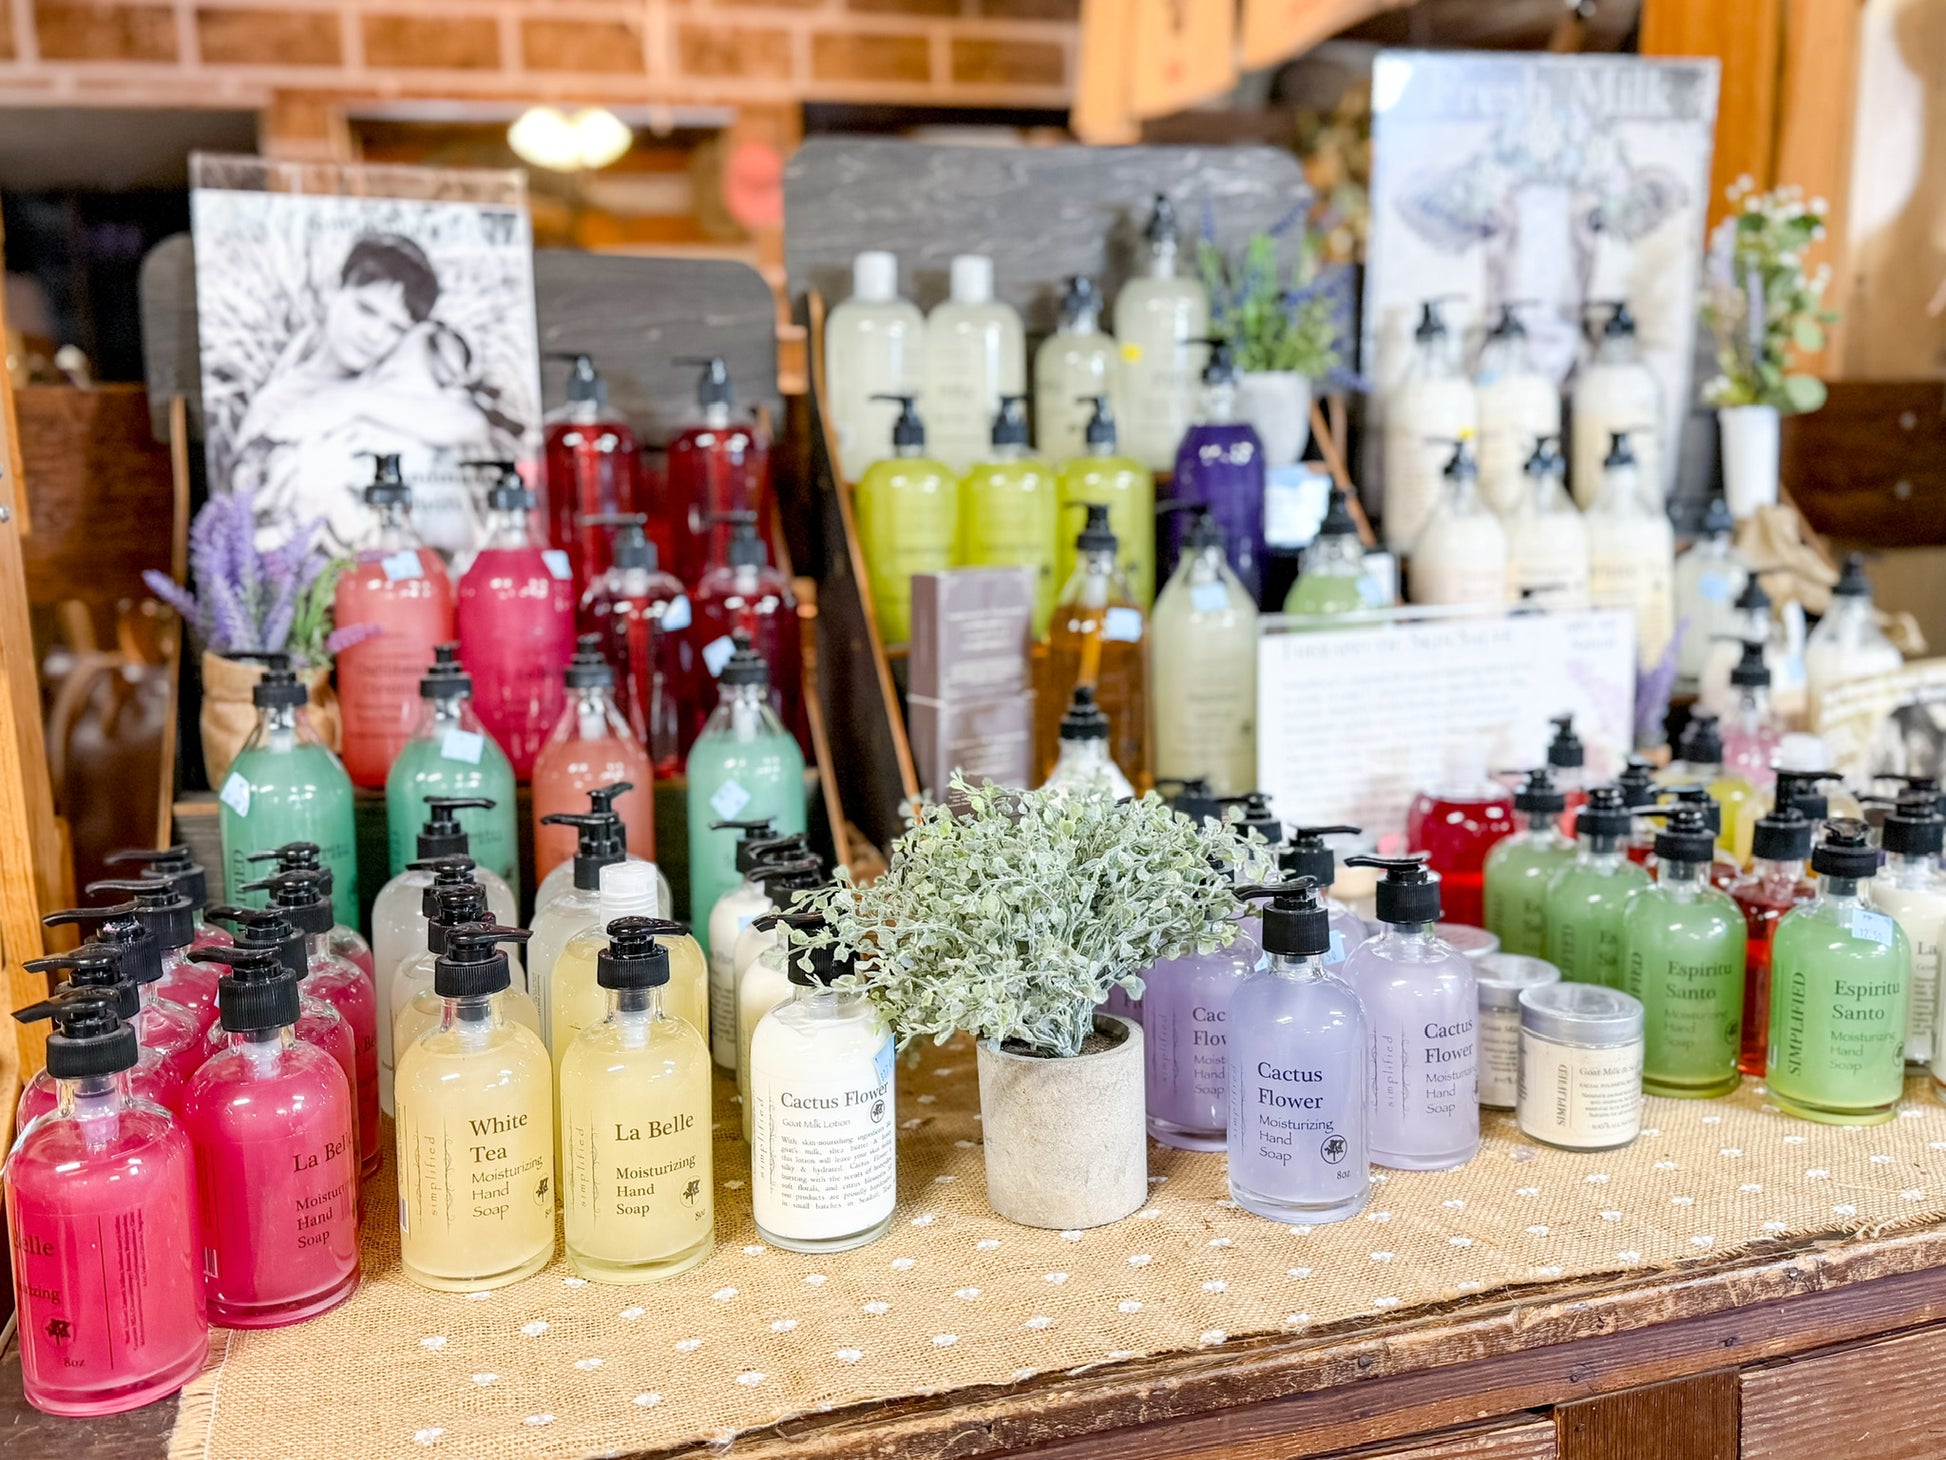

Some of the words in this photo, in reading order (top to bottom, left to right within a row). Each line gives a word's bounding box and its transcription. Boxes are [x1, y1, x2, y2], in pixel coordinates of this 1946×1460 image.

[1667, 960, 1733, 981] Espiritu
[1665, 984, 1717, 1000] Santo
[1834, 980, 1901, 1001] Espiritu
[1832, 1004, 1885, 1021] Santo
[1424, 1019, 1473, 1039] Cactus
[1788, 972, 1806, 1077] SIMPLIFIED
[1424, 1043, 1473, 1064] Flower
[1830, 1044, 1864, 1057] Hand
[1194, 1066, 1225, 1080] Hand
[1257, 1061, 1323, 1082] Cactus
[1382, 1035, 1399, 1108] simplified
[1829, 1060, 1863, 1076] Soap
[781, 1092, 839, 1109] Cactus
[844, 1082, 888, 1107] Flower
[1194, 1084, 1225, 1100] Soap
[1258, 1087, 1323, 1109] Flower
[1426, 1082, 1456, 1099] Hand
[1556, 1063, 1569, 1127] SIMPLIFIED
[1426, 1103, 1456, 1117] Soap
[469, 1113, 529, 1136] White
[615, 1123, 641, 1141] La
[648, 1113, 695, 1139] Belle
[782, 1118, 802, 1127] Goat
[823, 1119, 851, 1128] Lotion
[1259, 1114, 1334, 1134] Moisturizing
[1259, 1130, 1292, 1145] Hand
[292, 1153, 319, 1173] La
[470, 1145, 508, 1164] Tea
[1259, 1146, 1292, 1166] Soap
[424, 1135, 442, 1216] simplified
[471, 1155, 543, 1184] Moisturizing
[576, 1127, 590, 1208] simplified
[615, 1154, 697, 1180] Moisturizing
[472, 1181, 509, 1200] Hand
[616, 1183, 655, 1198] Hand
[297, 1206, 333, 1231] Hand
[472, 1203, 510, 1221] Soap
[616, 1203, 650, 1218] Soap
[298, 1230, 330, 1249] Soap
[63, 1357, 86, 1368] 8oz
